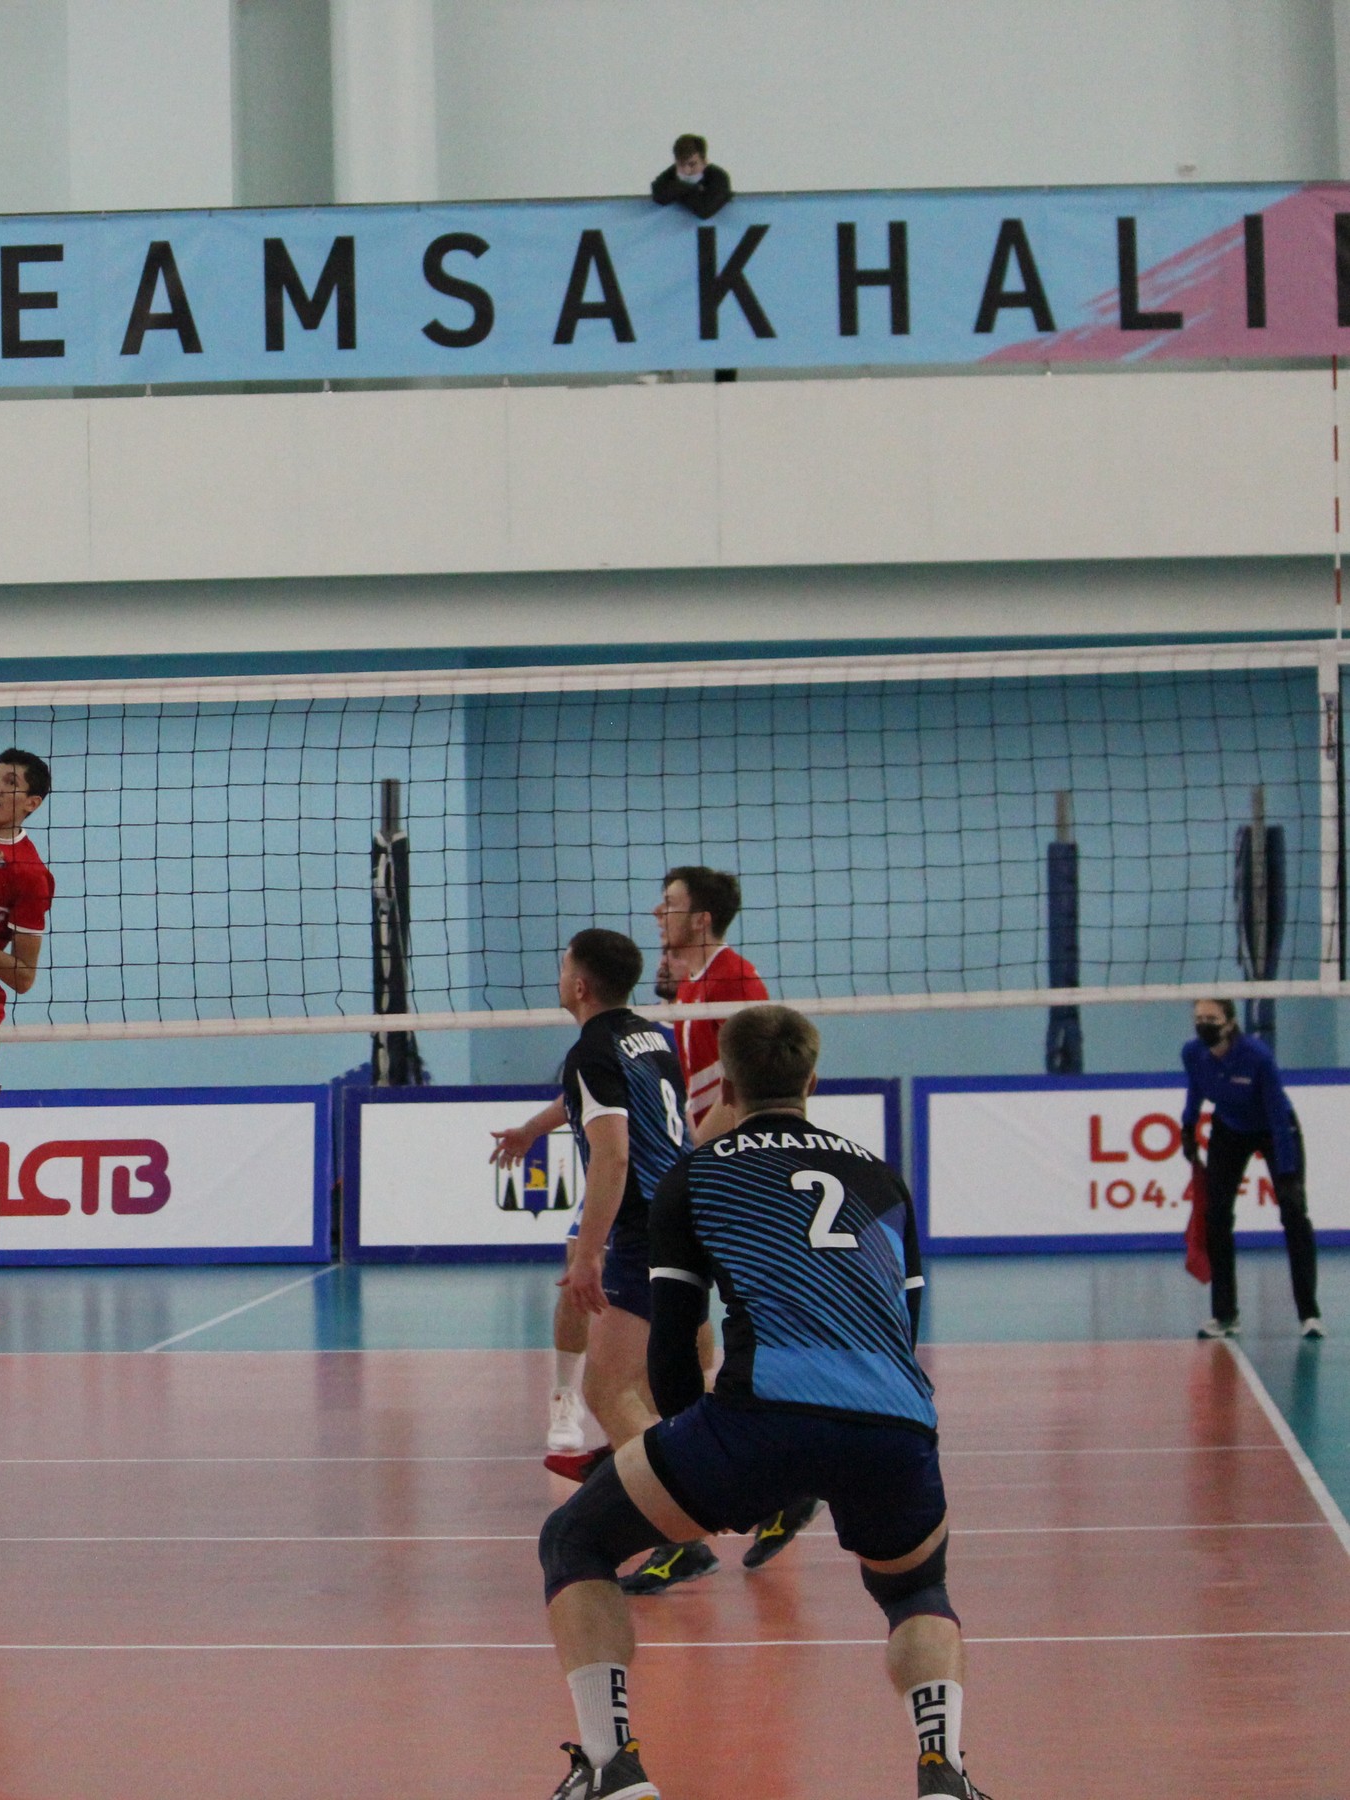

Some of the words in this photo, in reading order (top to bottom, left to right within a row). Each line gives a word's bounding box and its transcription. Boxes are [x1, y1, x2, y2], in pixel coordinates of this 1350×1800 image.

[660, 1078, 684, 1148] 8
[713, 1132, 873, 1163] САХАЛИН
[790, 1169, 859, 1249] 2
